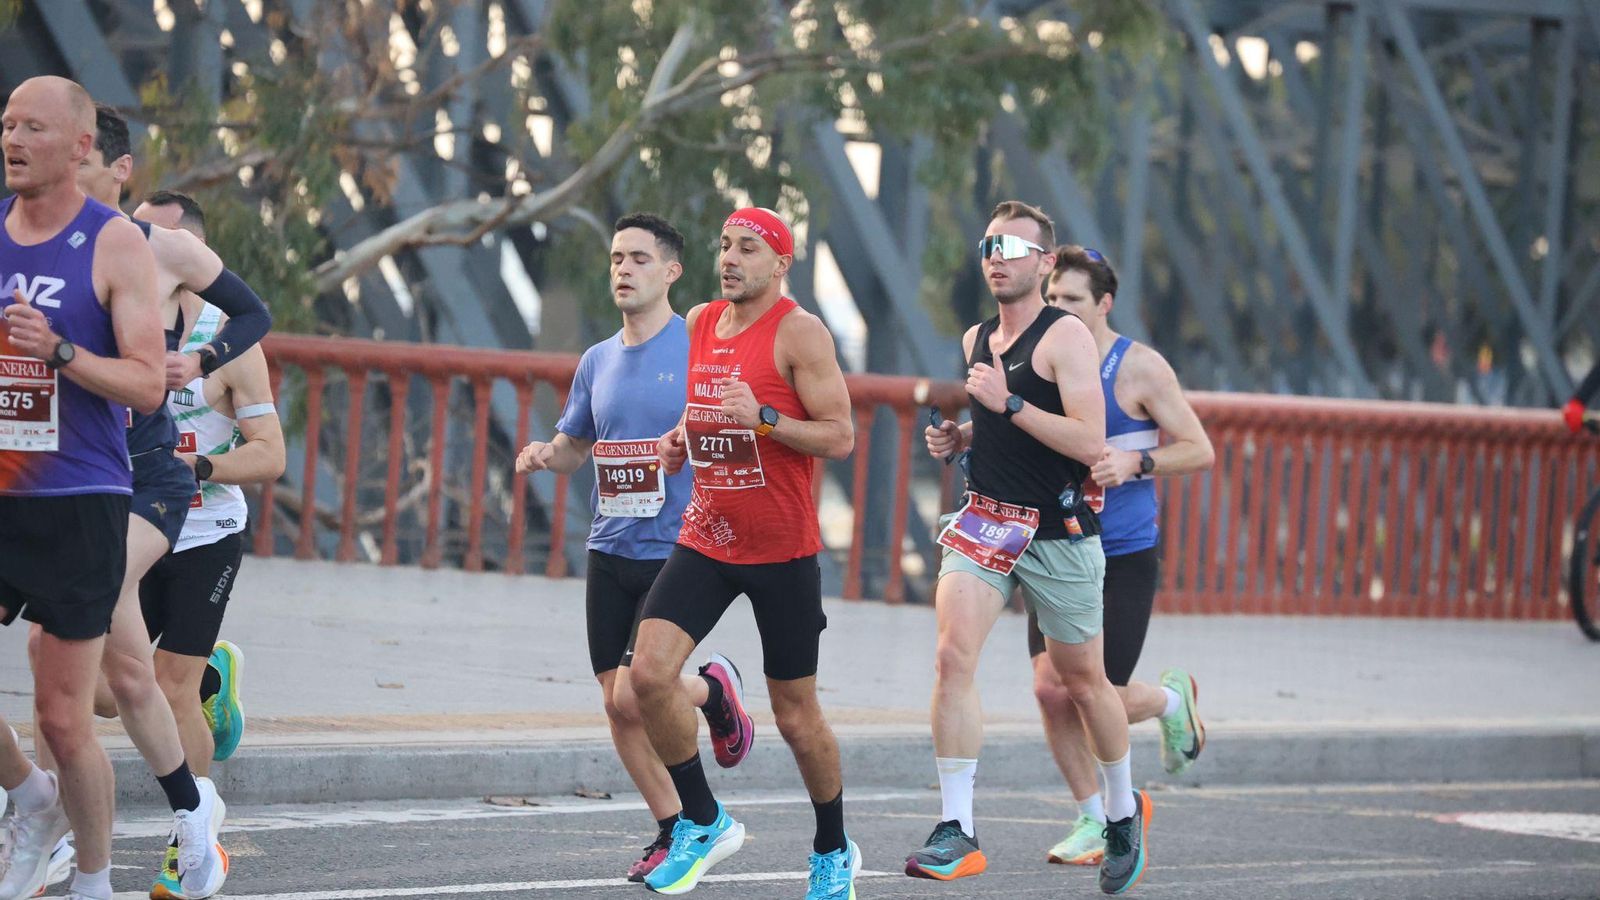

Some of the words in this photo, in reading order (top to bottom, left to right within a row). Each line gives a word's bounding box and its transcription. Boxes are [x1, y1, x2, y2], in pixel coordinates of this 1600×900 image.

[0, 361, 48, 377] NERALI
[694, 381, 725, 399] MÁLAG
[0, 391, 34, 410] 675
[605, 443, 654, 456] GENERALI
[700, 436, 733, 452] 2771
[605, 468, 645, 483] 14919
[979, 522, 1013, 540] 1897
